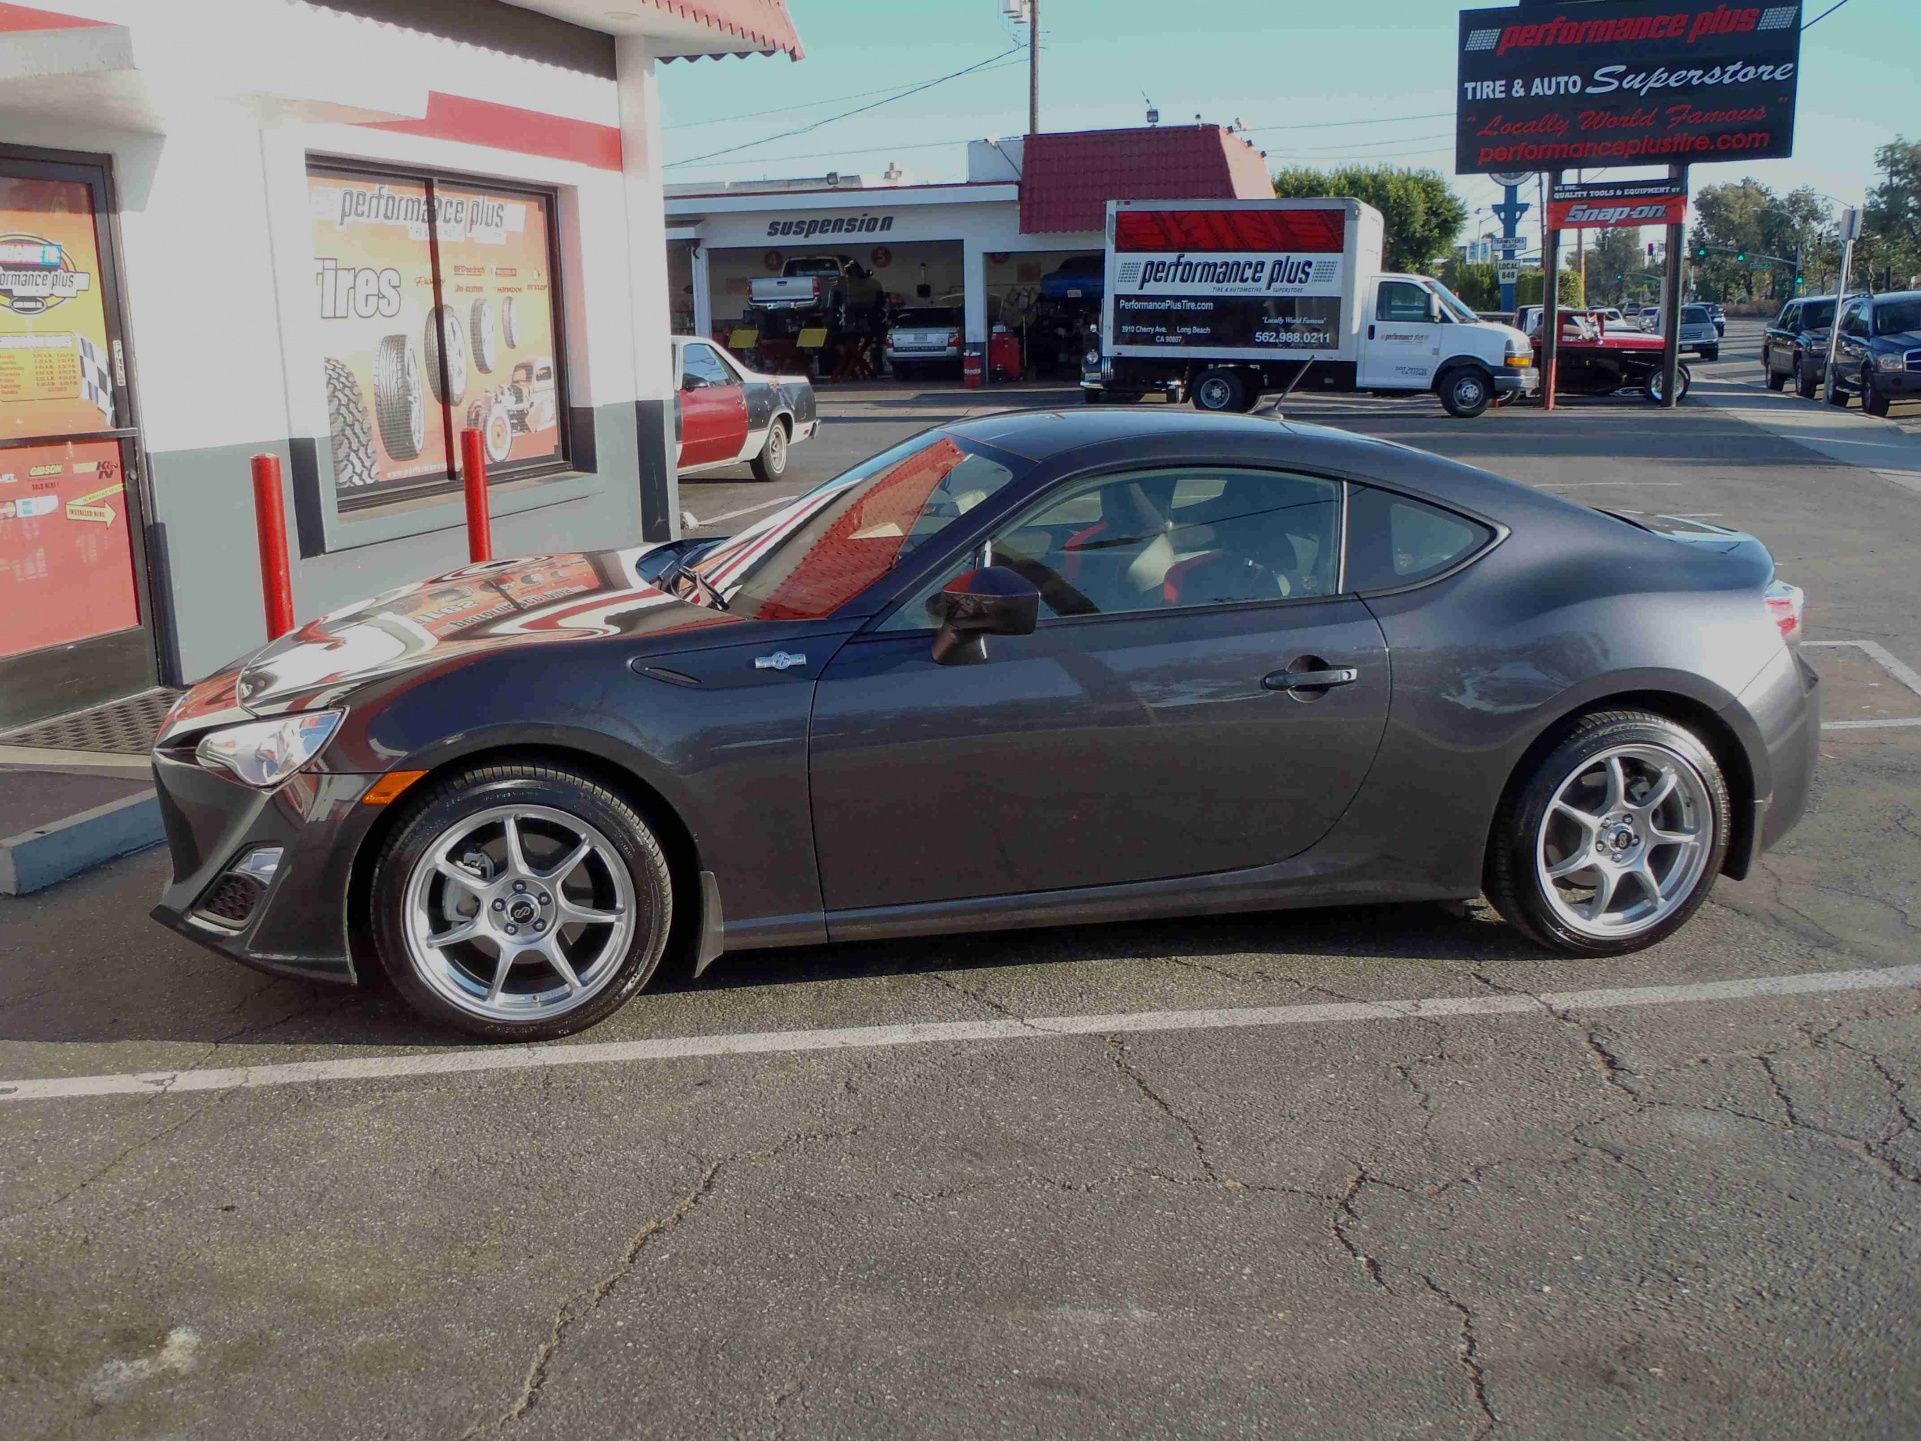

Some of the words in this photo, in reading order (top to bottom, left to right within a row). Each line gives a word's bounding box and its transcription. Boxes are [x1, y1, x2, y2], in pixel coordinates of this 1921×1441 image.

[1497, 13, 1688, 55] performance
[1687, 4, 1760, 43] plus
[1464, 80, 1505, 100] TIRE
[1512, 78, 1525, 97] &
[1530, 75, 1581, 96] AUTO
[1585, 61, 1794, 96] Superstore
[1578, 106, 1655, 131] World
[1554, 190, 1588, 199] QUALITY
[1624, 187, 1670, 195] EQUIPMENT
[469, 194, 505, 233] plus
[1565, 204, 1667, 224] Snap-on
[767, 213, 894, 238] suspension
[1138, 254, 1266, 290] performance
[1265, 256, 1313, 291] plus
[1499, 262, 1518, 270] LOCAL
[1502, 271, 1515, 279] 848
[52, 271, 75, 290] plus
[1119, 299, 1214, 311] PerformancePlusTire.com
[1135, 326, 1154, 334] Cherry
[1176, 326, 1191, 334] Long
[1192, 326, 1211, 334] Beach
[1255, 332, 1330, 343] 562.988.0211
[69, 508, 93, 517] INSTALLED
